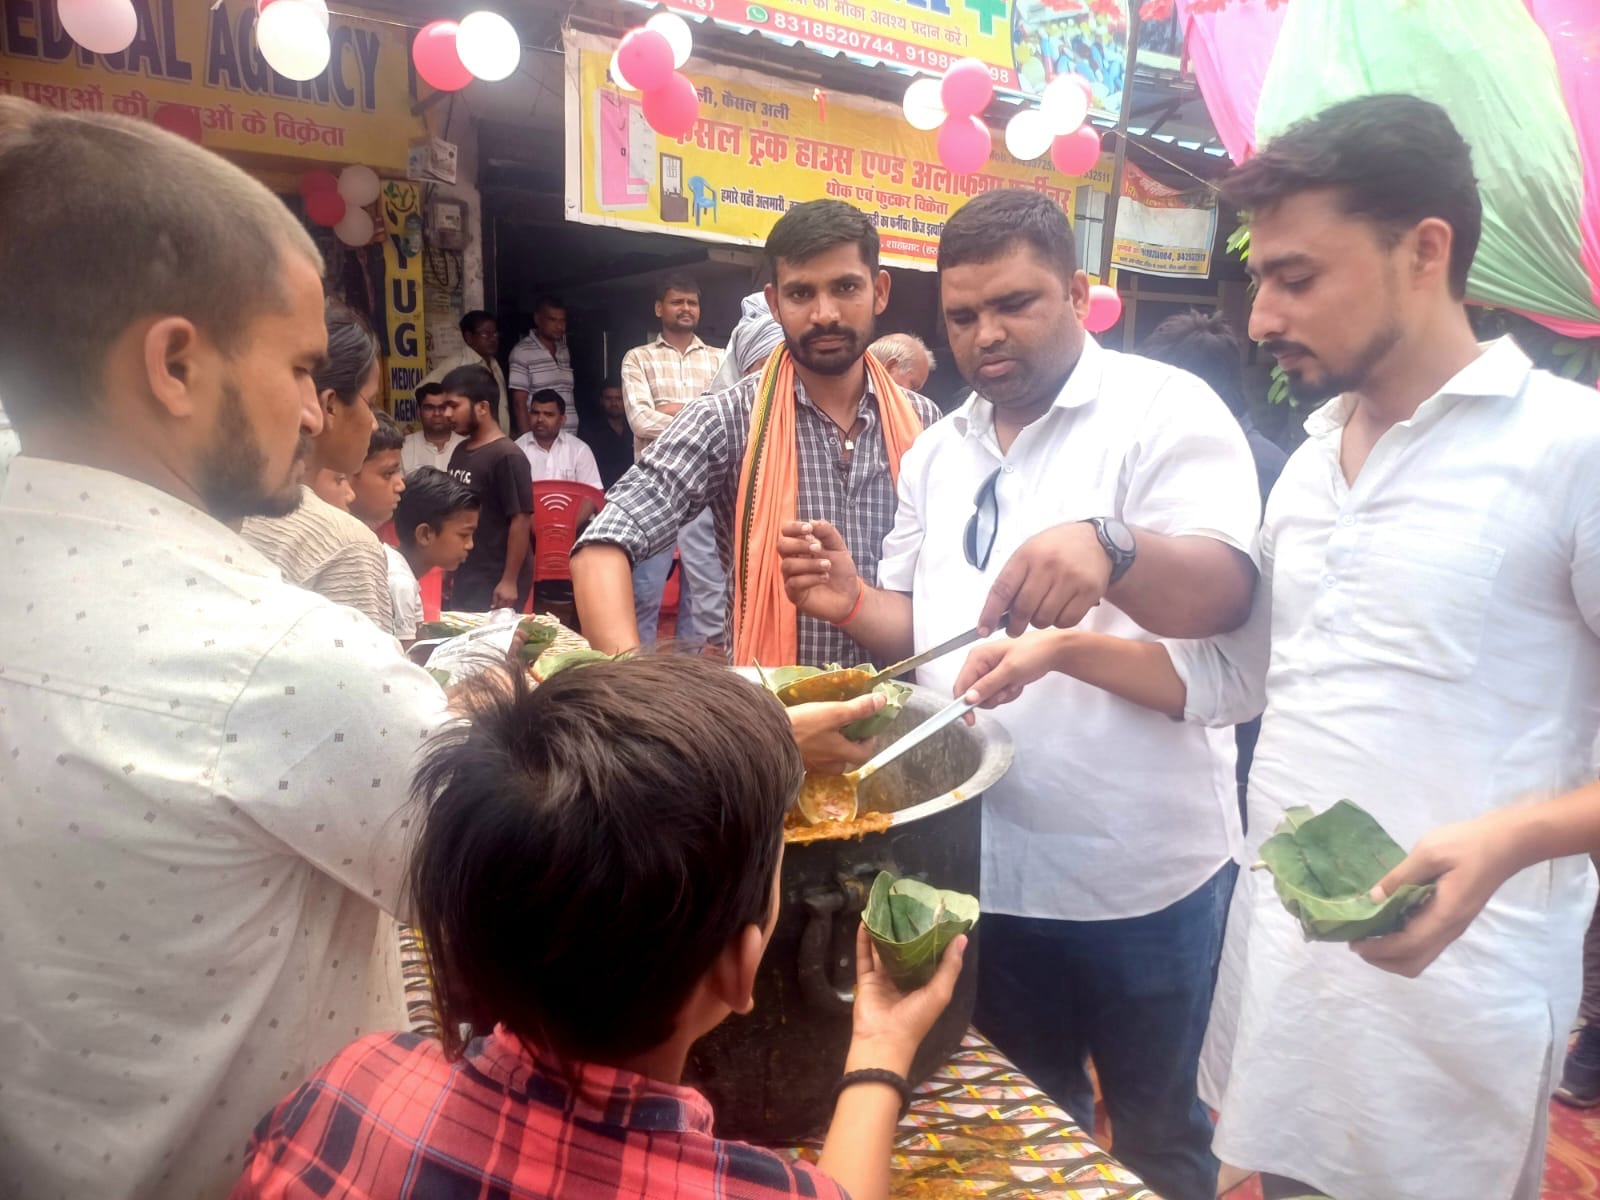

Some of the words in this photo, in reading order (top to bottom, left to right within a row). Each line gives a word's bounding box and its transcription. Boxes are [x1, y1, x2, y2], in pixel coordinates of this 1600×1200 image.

[870, 10, 907, 31] अवश्य
[911, 20, 941, 41] प्रदान
[208, 2, 380, 110] AGCY
[905, 46, 1010, 84] 919898
[241, 110, 268, 135] के
[274, 111, 346, 147] विक्रेता
[761, 102, 790, 121] अली
[795, 137, 855, 176] हाउस
[861, 150, 906, 185] एण्ड
[721, 187, 739, 204] हमारे
[826, 179, 852, 199] थोक
[855, 186, 874, 203] एवं
[914, 194, 949, 215] विक्रेता
[394, 399, 417, 421] AGEN
